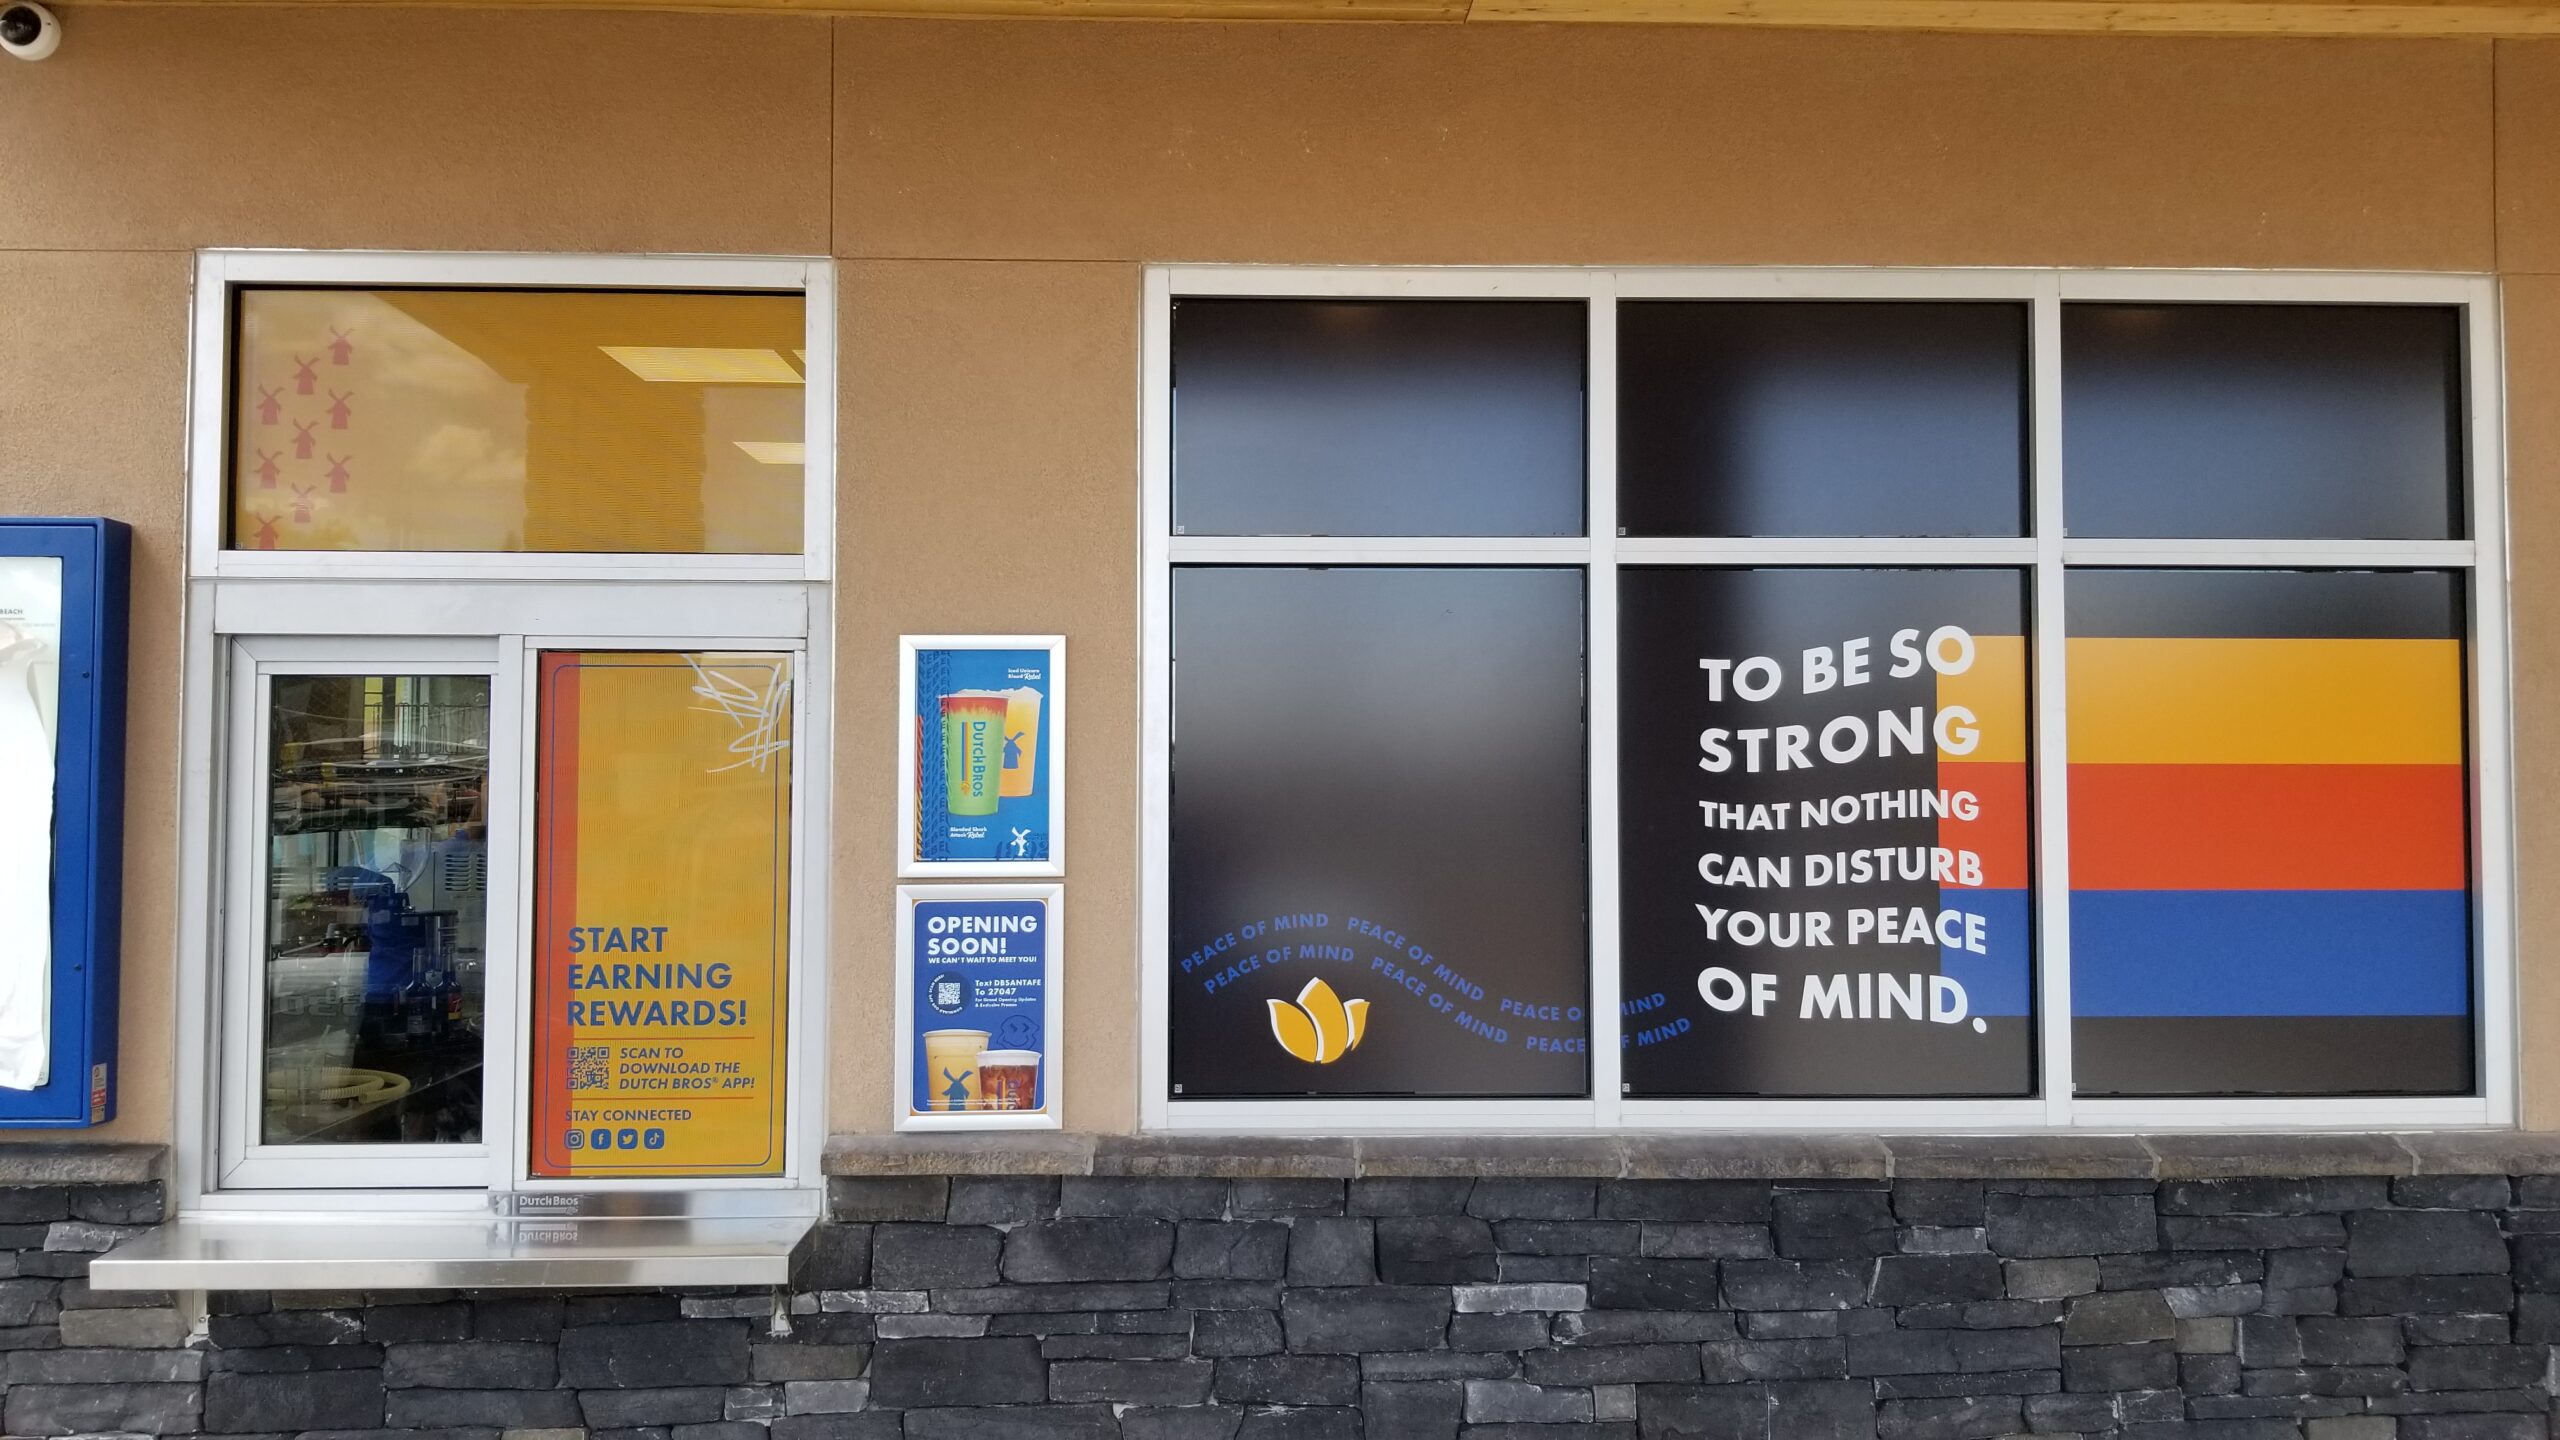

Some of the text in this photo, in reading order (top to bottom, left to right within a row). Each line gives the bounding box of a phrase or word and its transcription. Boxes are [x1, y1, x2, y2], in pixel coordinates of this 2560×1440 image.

[1699, 625, 1976, 702] TO BE SO
[1699, 705, 1980, 774] STRONG
[1699, 788, 1979, 831] THAT NOTHING
[1698, 846, 1984, 888] CAN DISTURB
[927, 915, 1038, 934] OPENING
[1695, 903, 1987, 955] YOUR PEACE
[568, 926, 669, 953] START
[927, 937, 1008, 956] SOON!
[1181, 913, 1329, 973] PEACE OF MIND
[1203, 944, 1355, 994] PEACE OF MIND
[1347, 916, 1485, 1001] PEACE OF MIND
[567, 962, 733, 990] EARNING
[994, 979, 1042, 987] DBSANTAFE
[975, 988, 985, 996] To
[1371, 956, 1509, 1044] PEACE OF MIND
[1697, 966, 1987, 1034] OF MIND.
[567, 999, 748, 1027] REWARDS!
[1500, 997, 1561, 1021] PEACE
[1567, 1007, 1582, 1021] O
[1526, 1017, 1691, 1053] PEACE F MIND
[619, 1047, 684, 1059] SCAN TO
[619, 1062, 741, 1074] DOWNLOAD THE
[619, 1078, 668, 1090] DUTCH
[722, 1077, 756, 1089] APP!
[565, 1109, 692, 1122] STAY CONNECTED
